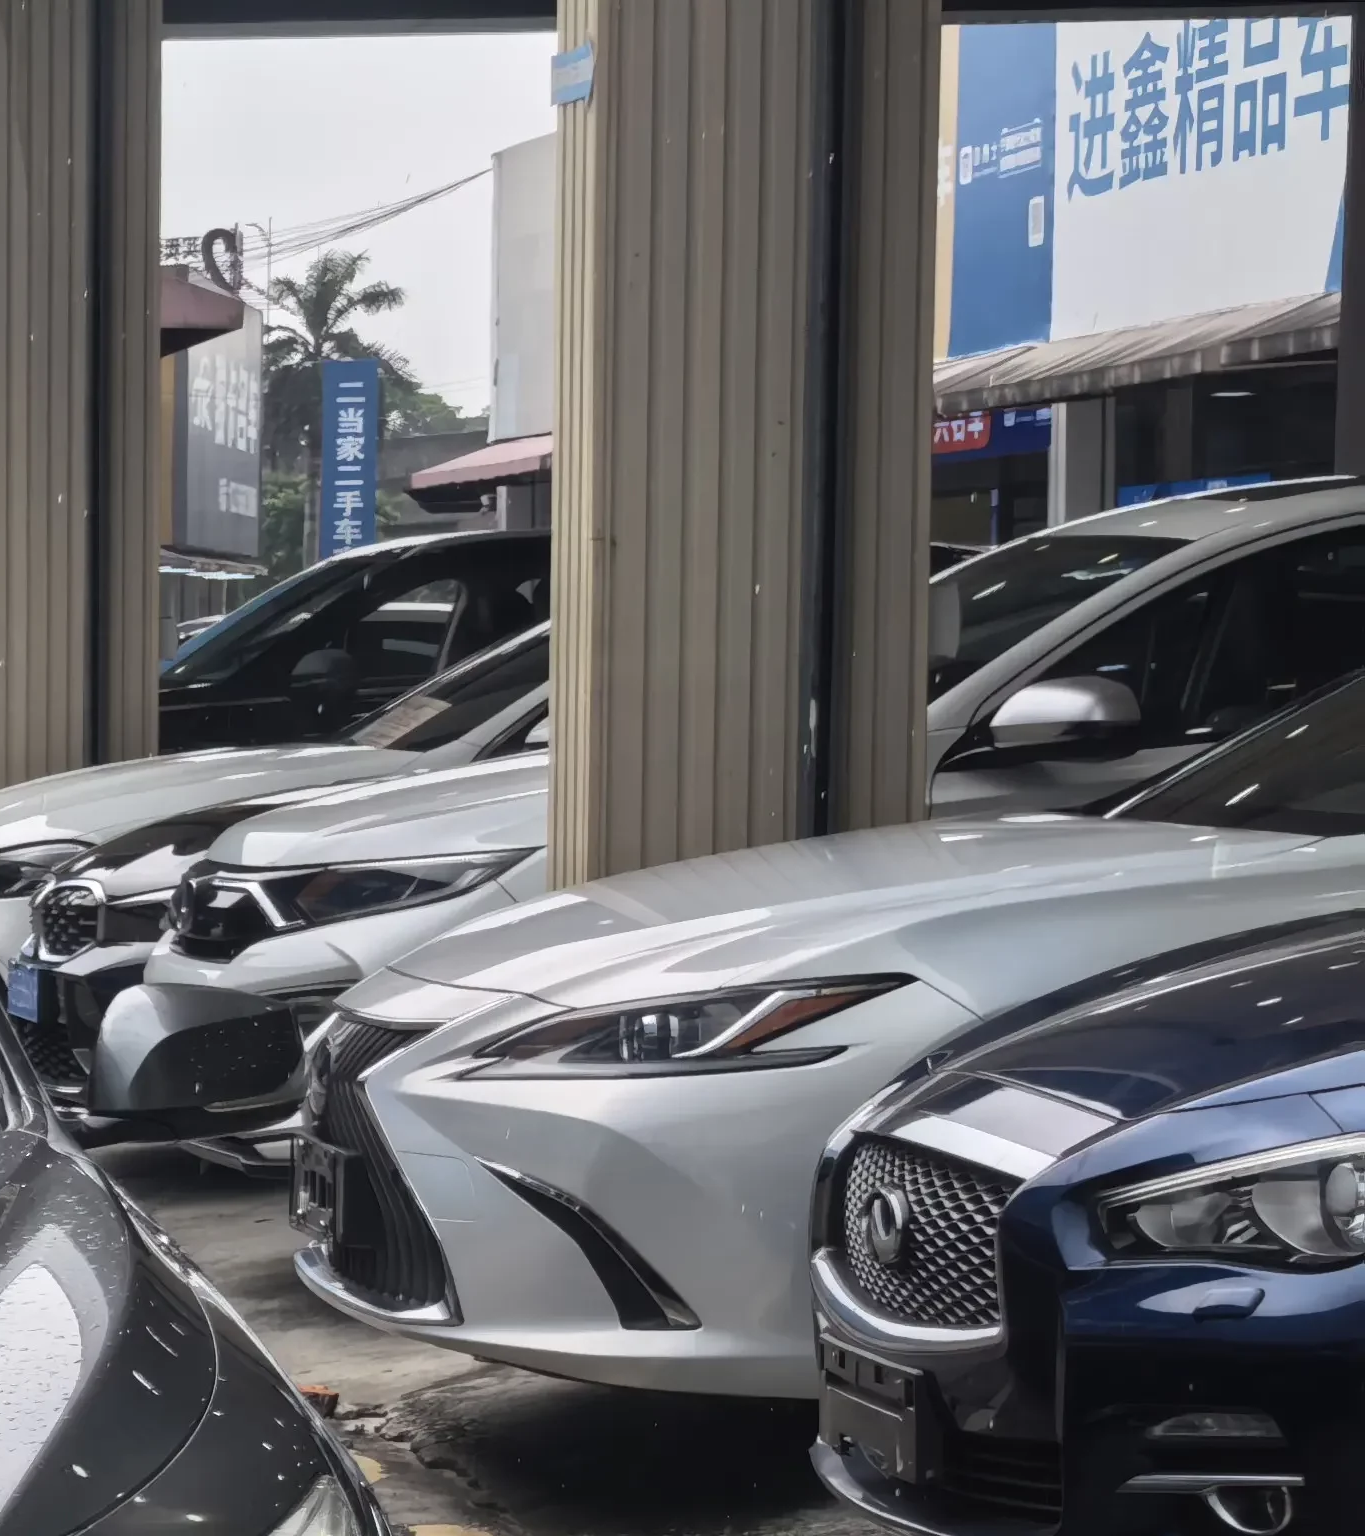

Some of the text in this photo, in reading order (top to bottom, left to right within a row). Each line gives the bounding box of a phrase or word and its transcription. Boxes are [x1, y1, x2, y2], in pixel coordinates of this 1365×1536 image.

[1067, 17, 1351, 204] 进鑫精品车
[333, 381, 365, 554] 二当家二手车
